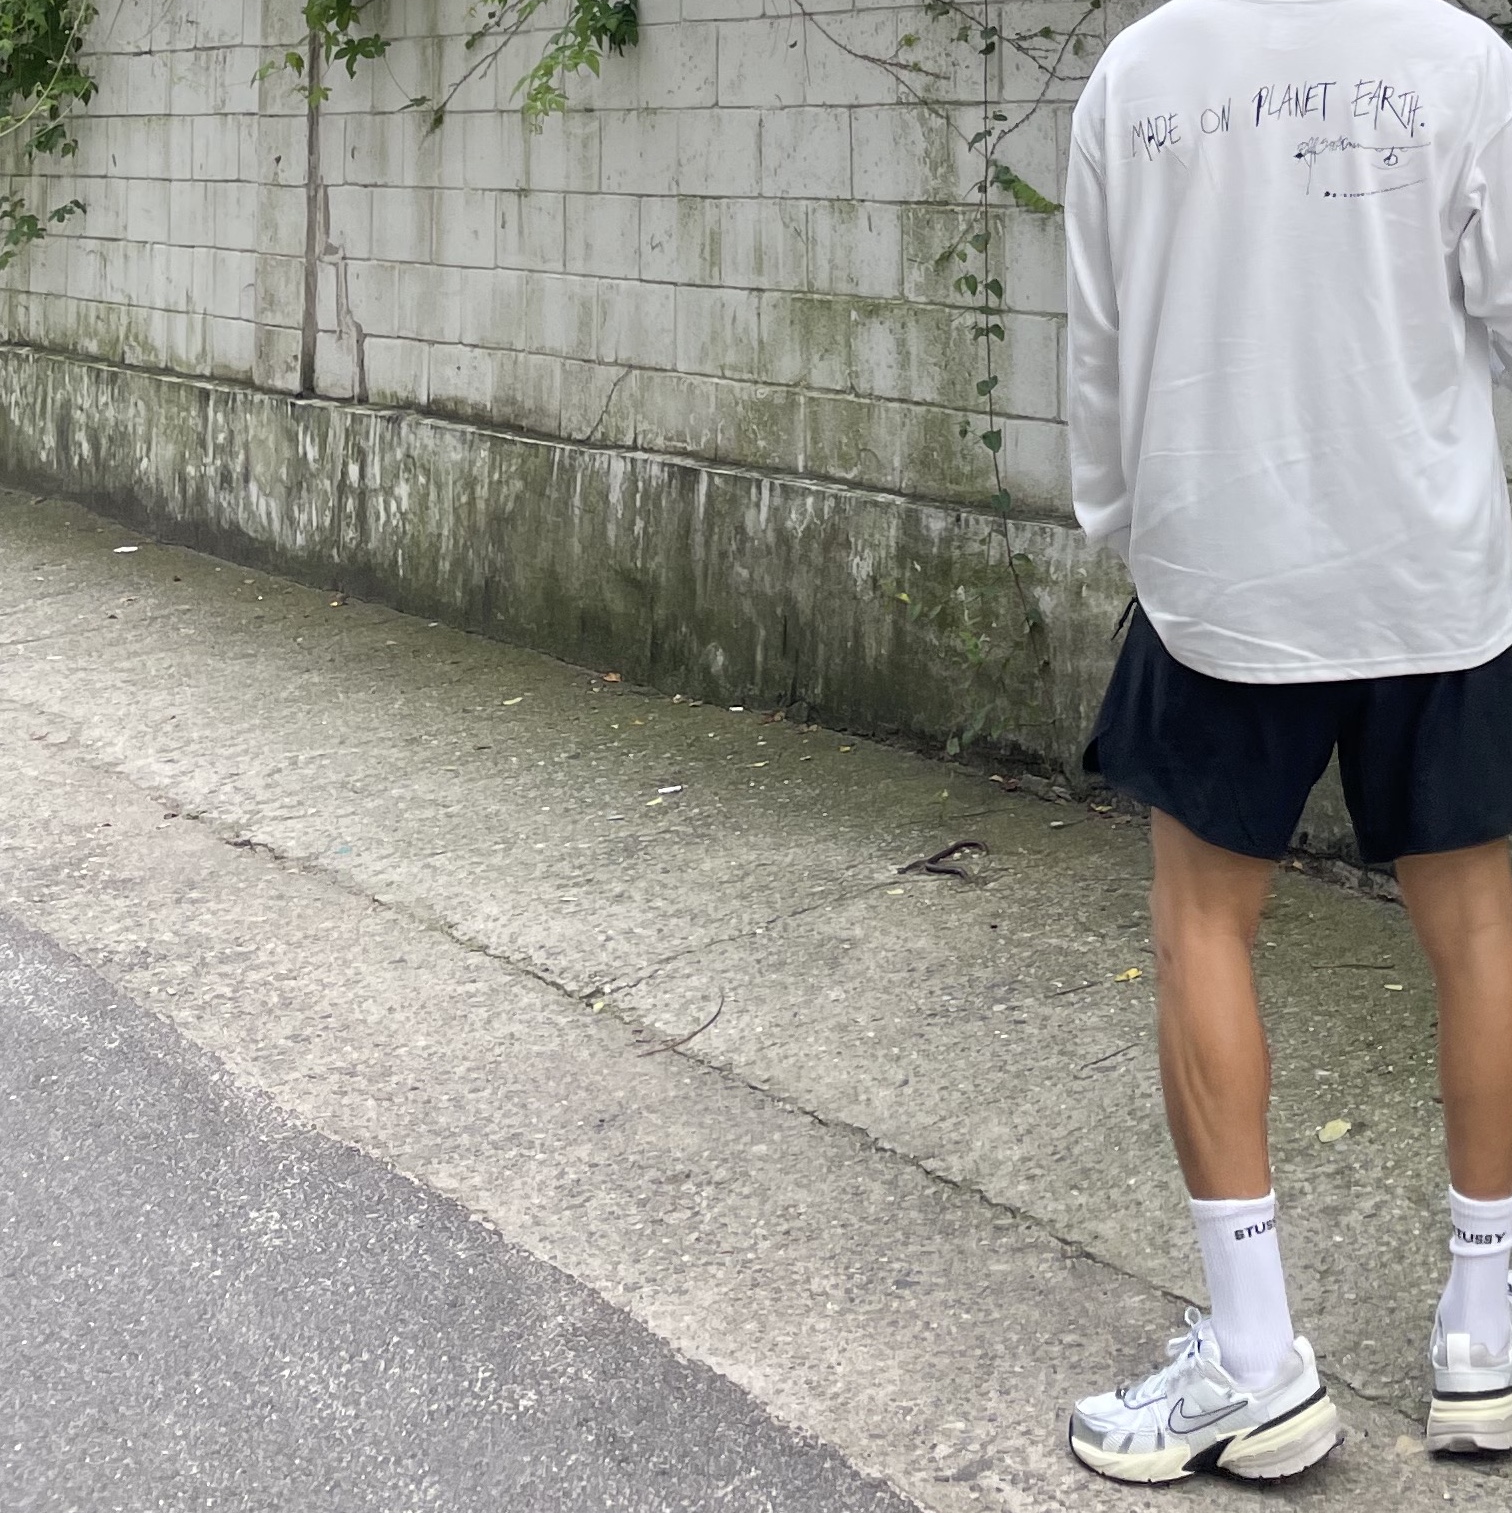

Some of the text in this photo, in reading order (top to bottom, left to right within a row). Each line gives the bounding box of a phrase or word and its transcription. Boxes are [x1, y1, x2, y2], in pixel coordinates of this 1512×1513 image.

[1131, 79, 1426, 161] MADE ON PLANET EARTH.
